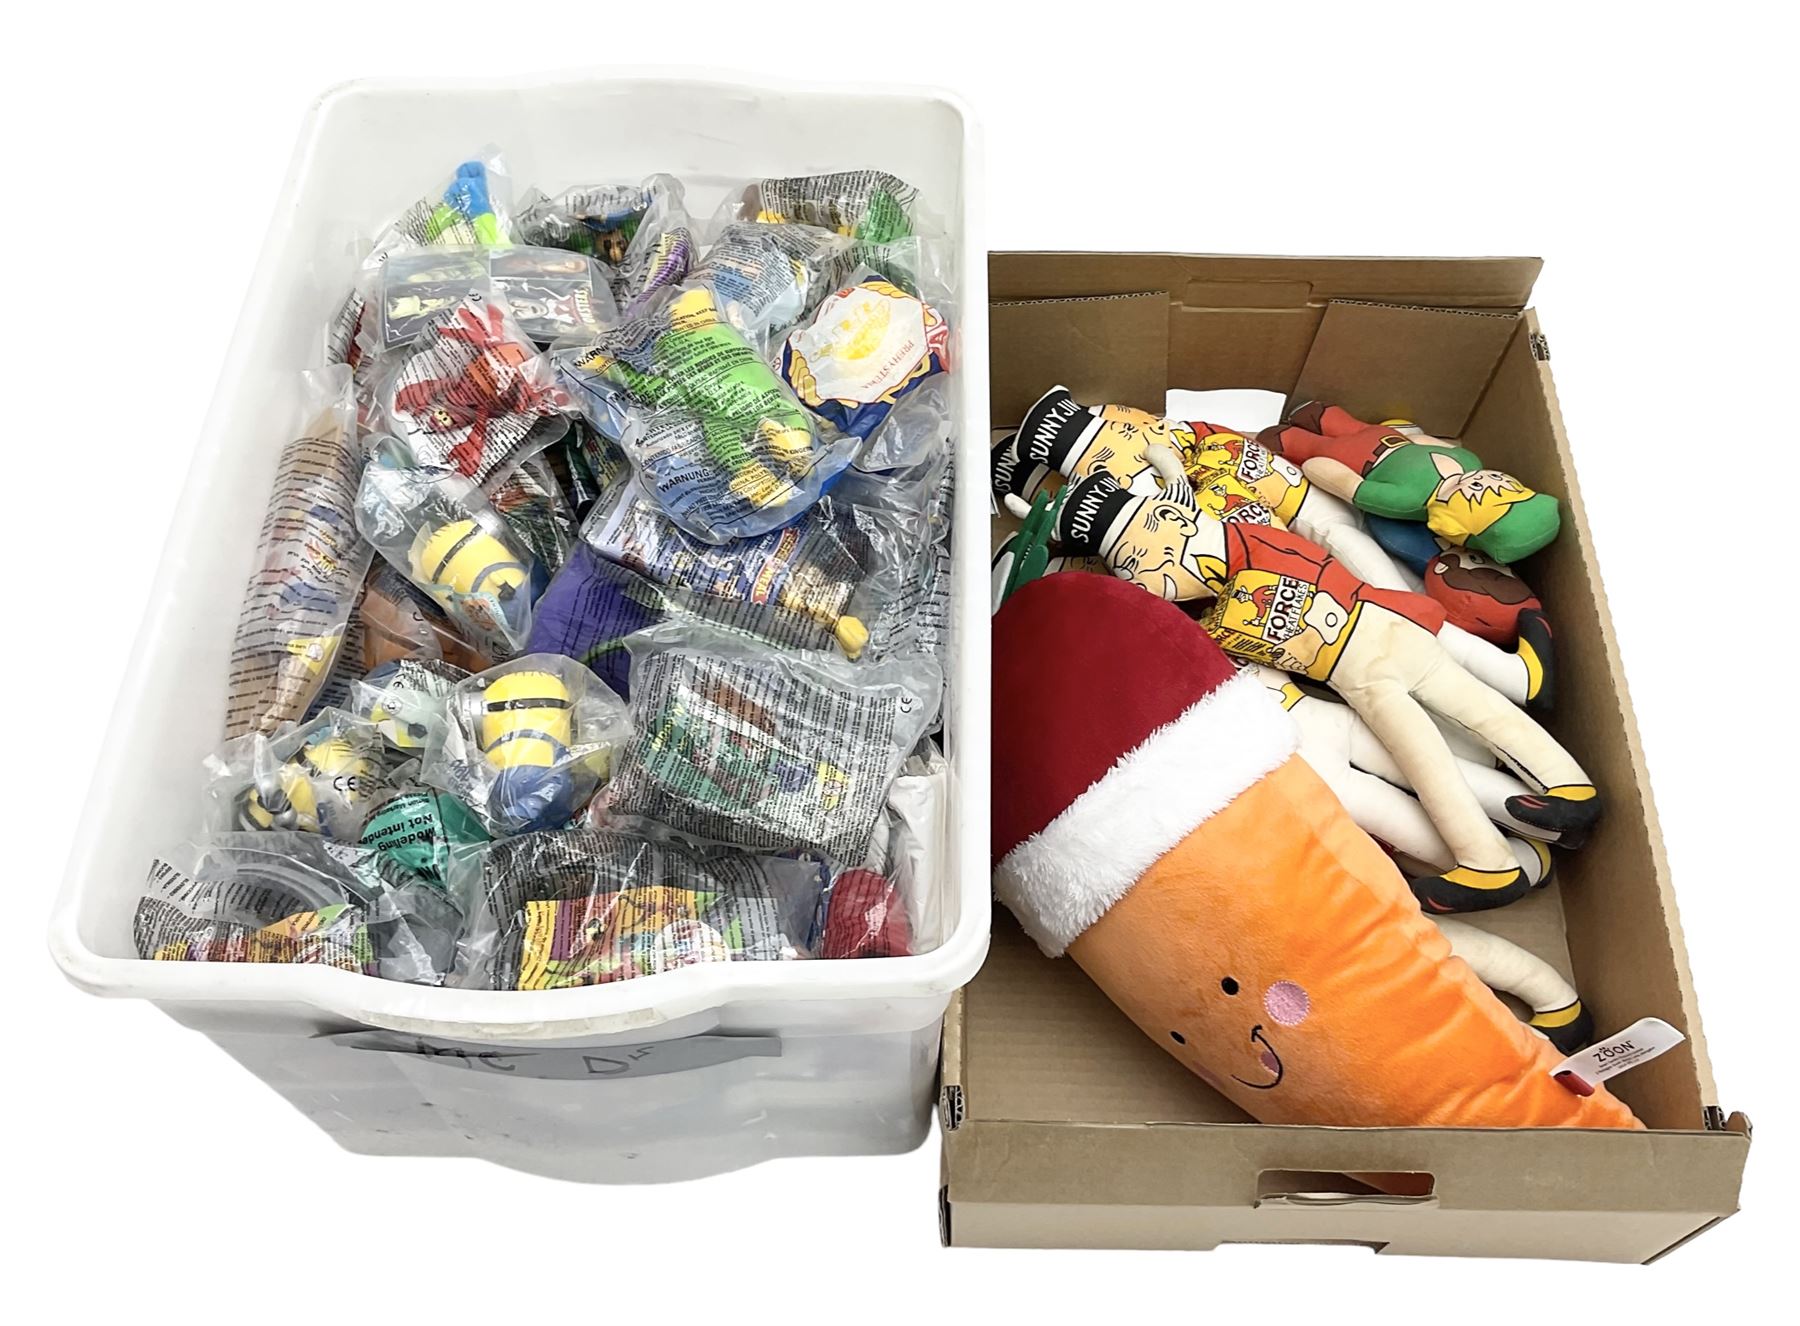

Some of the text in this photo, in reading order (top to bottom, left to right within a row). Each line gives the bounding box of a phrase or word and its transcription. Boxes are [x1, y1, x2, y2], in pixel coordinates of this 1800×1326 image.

[1030, 407, 1067, 464] SUNNY
[658, 466, 712, 494] WARNUNG:
[1071, 484, 1109, 543] SUNNY
[1267, 577, 1299, 641] FORCE
[1290, 582, 1308, 615] FLAKES
[900, 697, 912, 713] CE
[333, 776, 356, 791] CE
[410, 814, 433, 829] Not
[1593, 1040, 1635, 1063] ZOON
